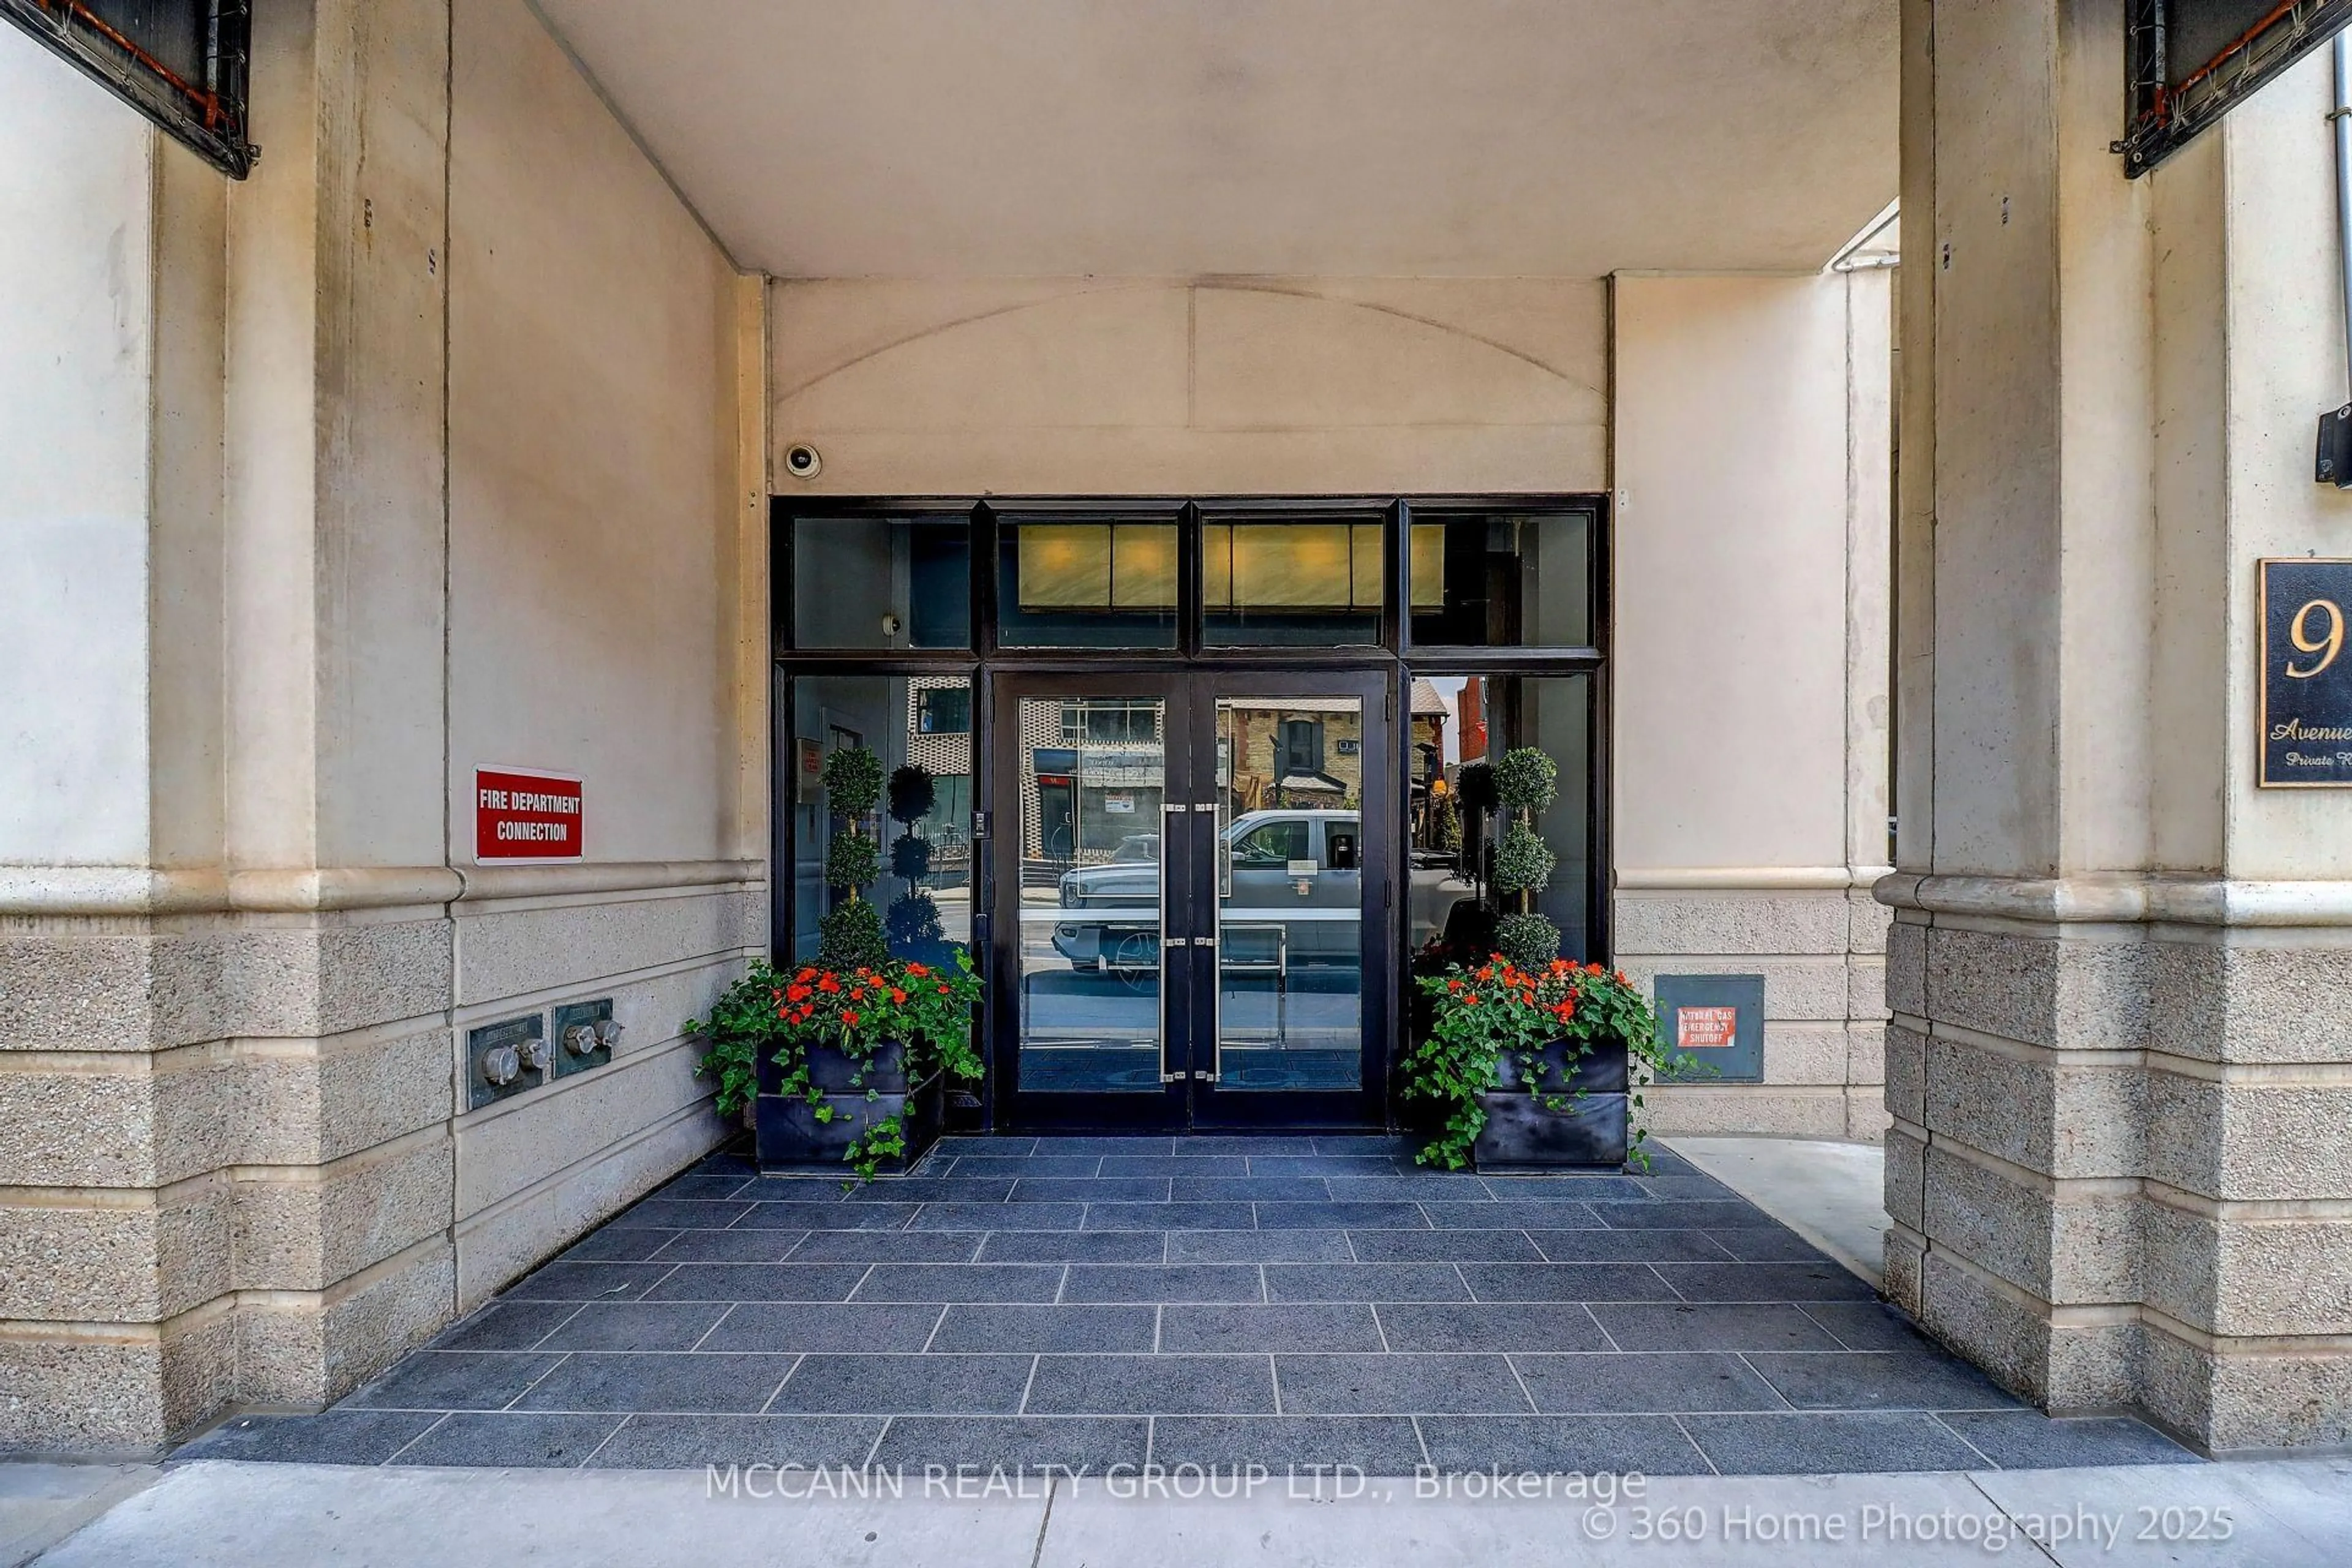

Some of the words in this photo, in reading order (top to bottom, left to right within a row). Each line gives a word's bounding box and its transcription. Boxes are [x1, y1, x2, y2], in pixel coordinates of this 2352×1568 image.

[2286, 600, 2345, 679] 9
[2270, 717, 2352, 740] Avenue
[2285, 752, 2334, 766] Private
[480, 789, 508, 809] FIRE
[511, 791, 580, 814] DEPARTMENT
[497, 821, 567, 841] CONNECTION
[1680, 1011, 1714, 1020] NATURAL
[1717, 1011, 1732, 1020] GAS
[1684, 1022, 1728, 1031] EMERGENCY
[1690, 1033, 1723, 1042] SHUTOFF
